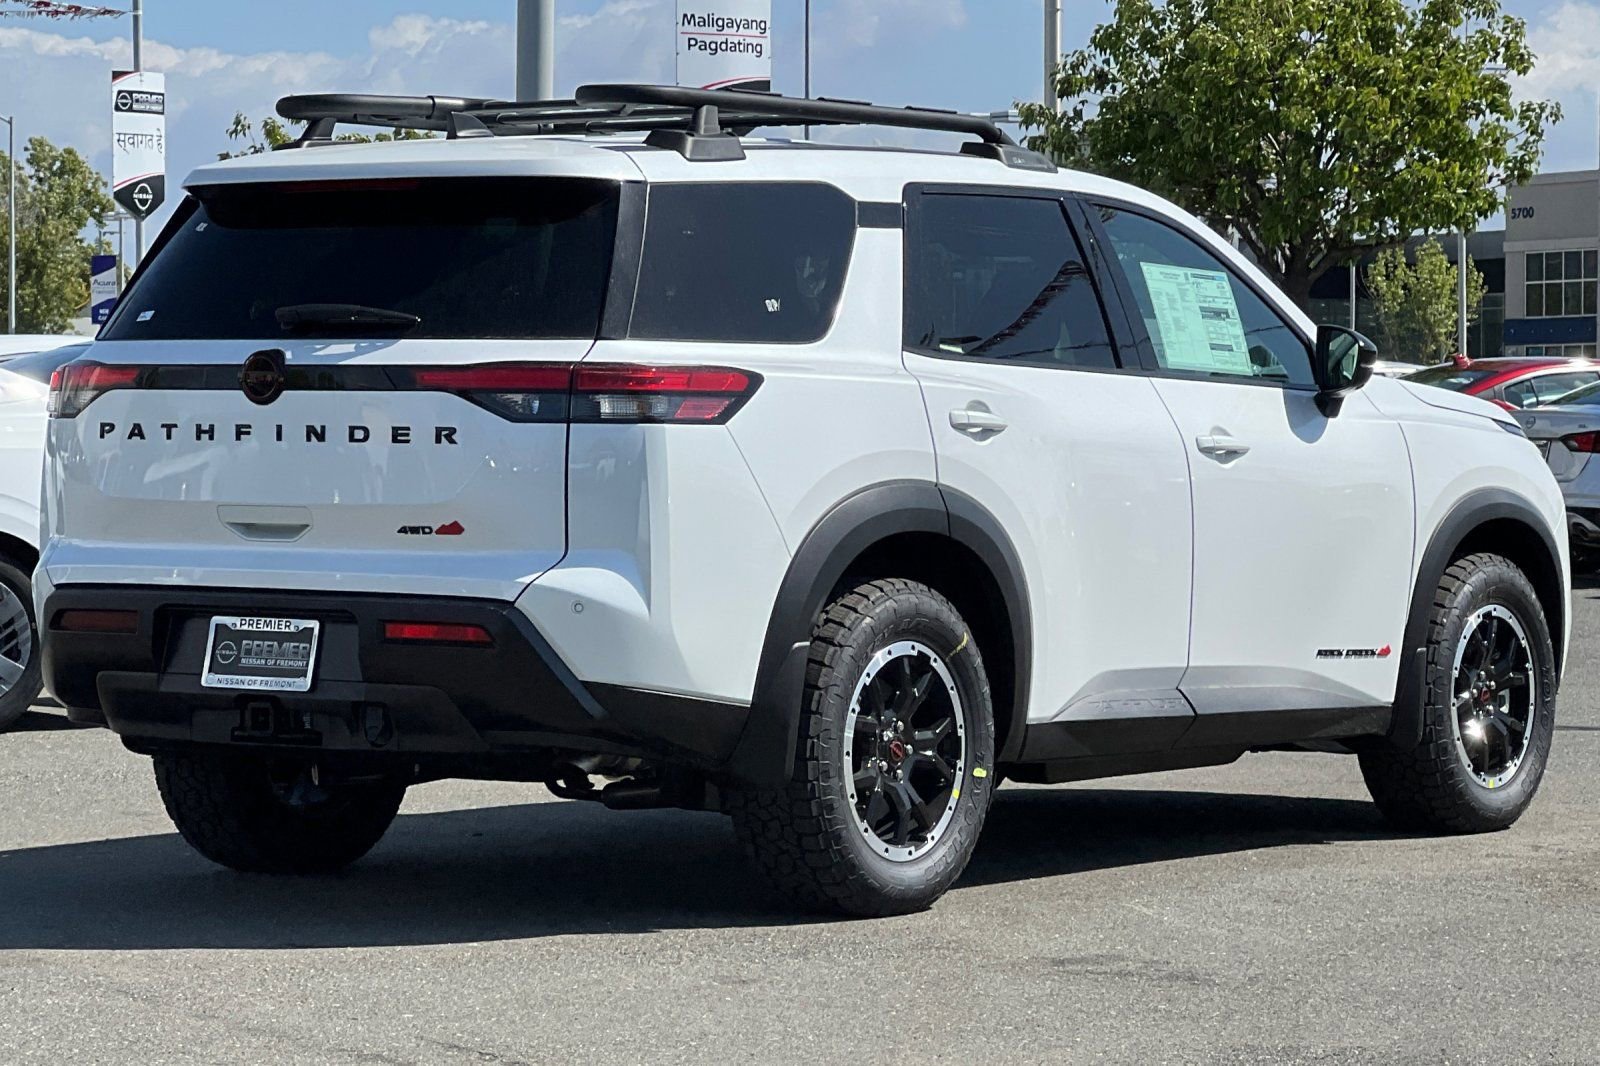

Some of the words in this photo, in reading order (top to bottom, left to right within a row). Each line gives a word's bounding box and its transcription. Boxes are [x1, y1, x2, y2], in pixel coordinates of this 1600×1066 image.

[681, 12, 767, 34] Maligayang
[687, 37, 763, 58] Pagdating
[1510, 206, 1535, 220] 5700
[93, 279, 116, 287] Acura
[99, 422, 458, 445] PATHFINDER
[397, 525, 434, 535] 4WD
[239, 618, 292, 630] PREMIER
[241, 639, 310, 660] PREMIER
[241, 658, 265, 666] NISSAN
[276, 659, 307, 667] FREMONT
[216, 678, 245, 686] NISSAN
[259, 680, 297, 688] FREMONT
